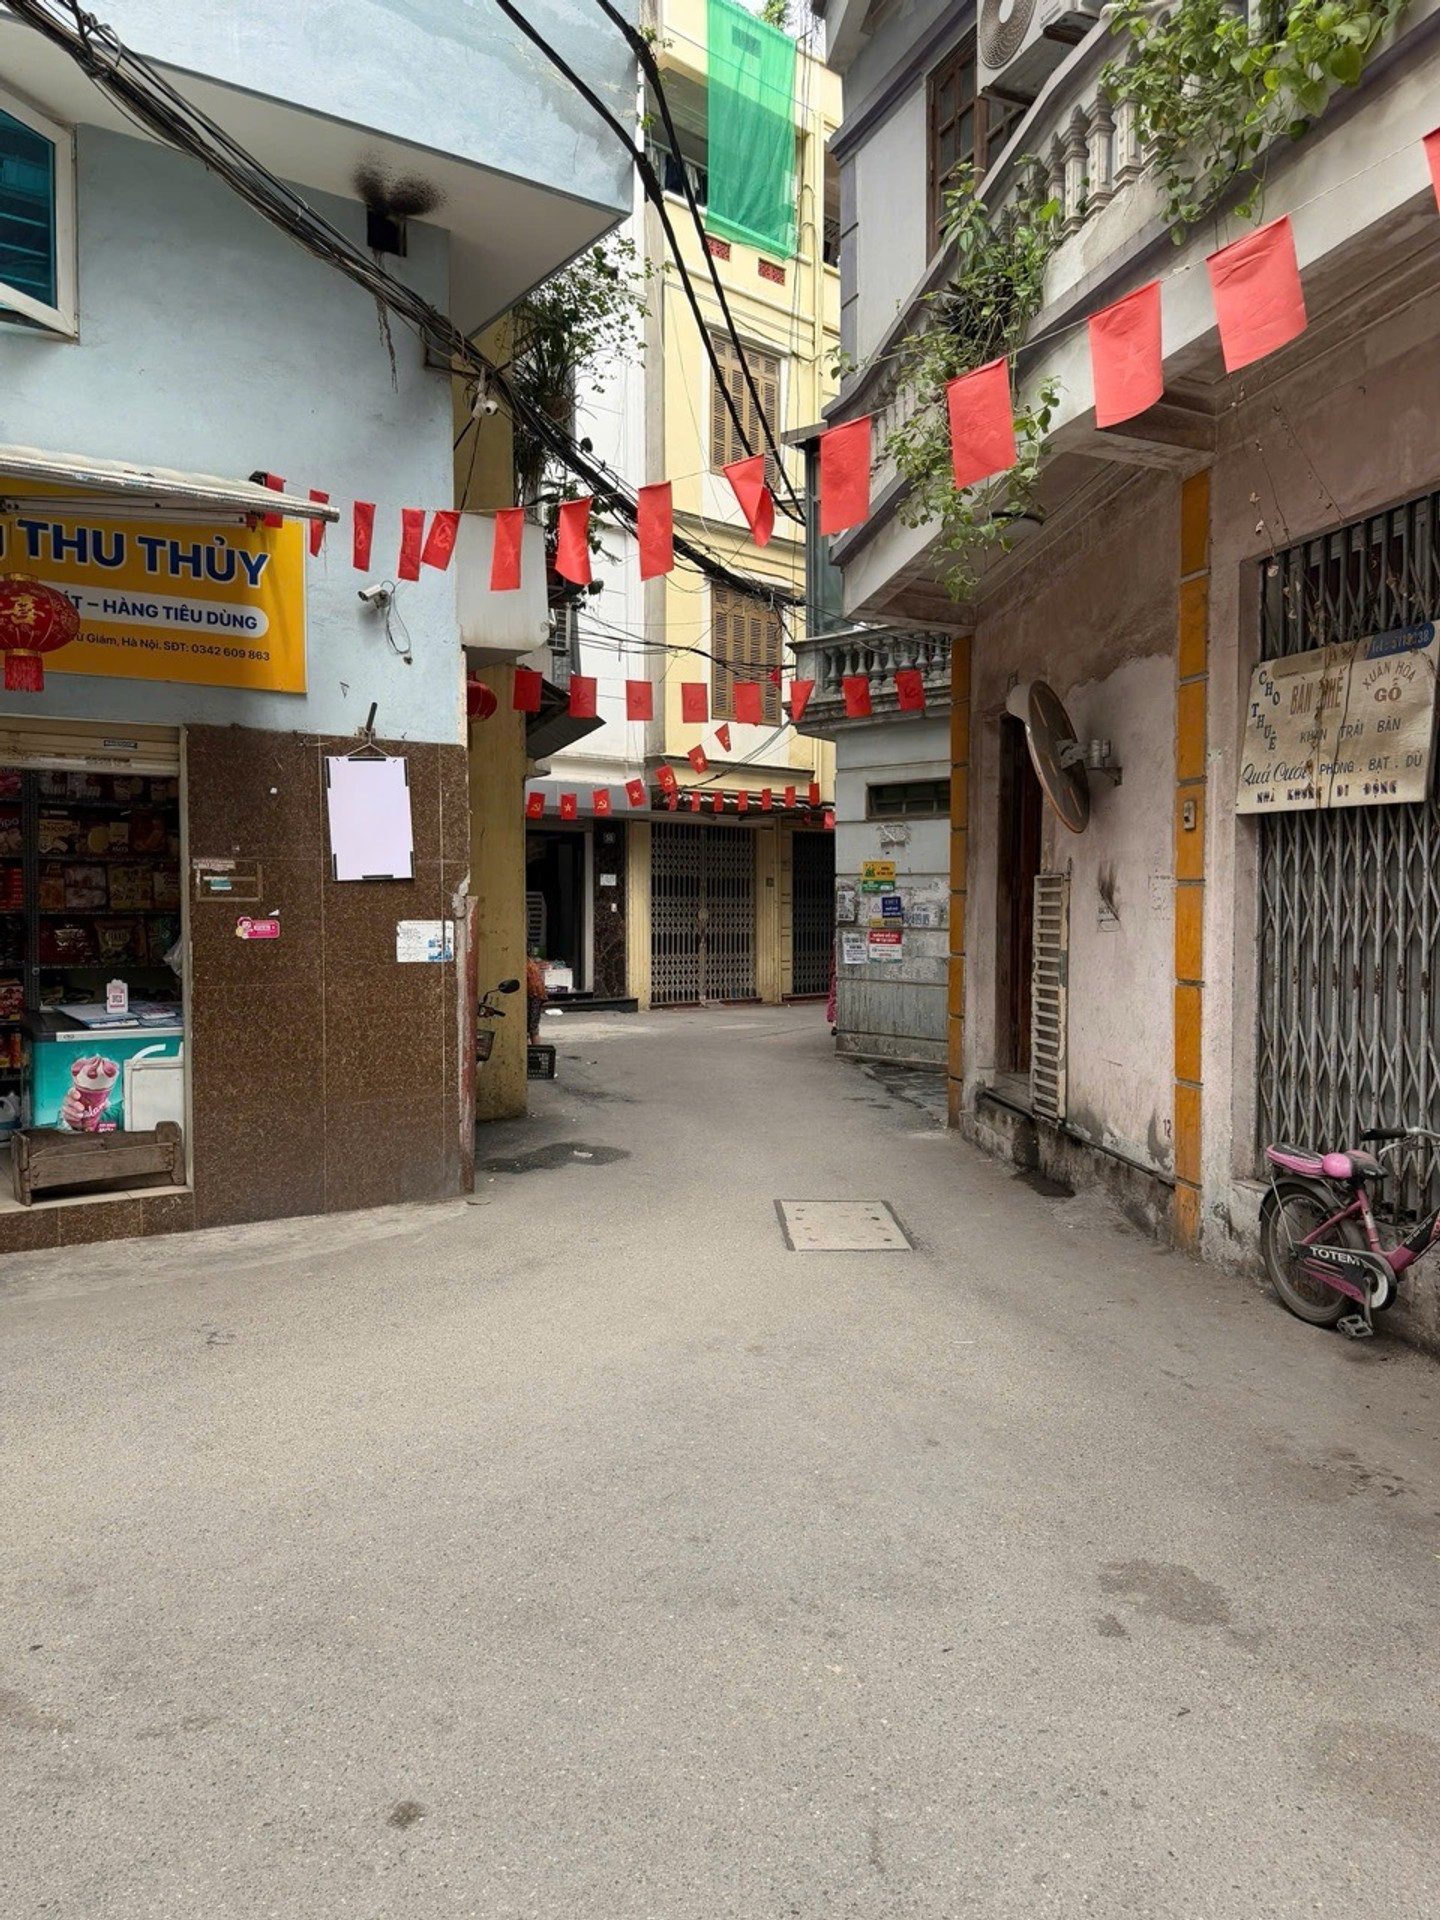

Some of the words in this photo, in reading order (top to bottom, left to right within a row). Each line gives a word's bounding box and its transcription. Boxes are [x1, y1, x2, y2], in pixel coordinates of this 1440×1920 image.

[17, 518, 126, 568] THU
[138, 536, 268, 586] THỦY
[104, 596, 158, 618] HÀNG
[163, 603, 203, 623] TIÊU
[207, 609, 258, 629] DÙNG
[122, 636, 138, 648] Hà
[164, 640, 189, 652] SĐT:
[191, 644, 221, 656] 0342
[224, 647, 246, 658] 609
[1258, 670, 1281, 706] CHO
[1363, 661, 1392, 690] XUÂN
[1374, 677, 1403, 703] GỖ
[1251, 703, 1277, 751] THUÊ
[1377, 716, 1402, 733] BÀN
[1309, 1246, 1363, 1266] TOTEM
